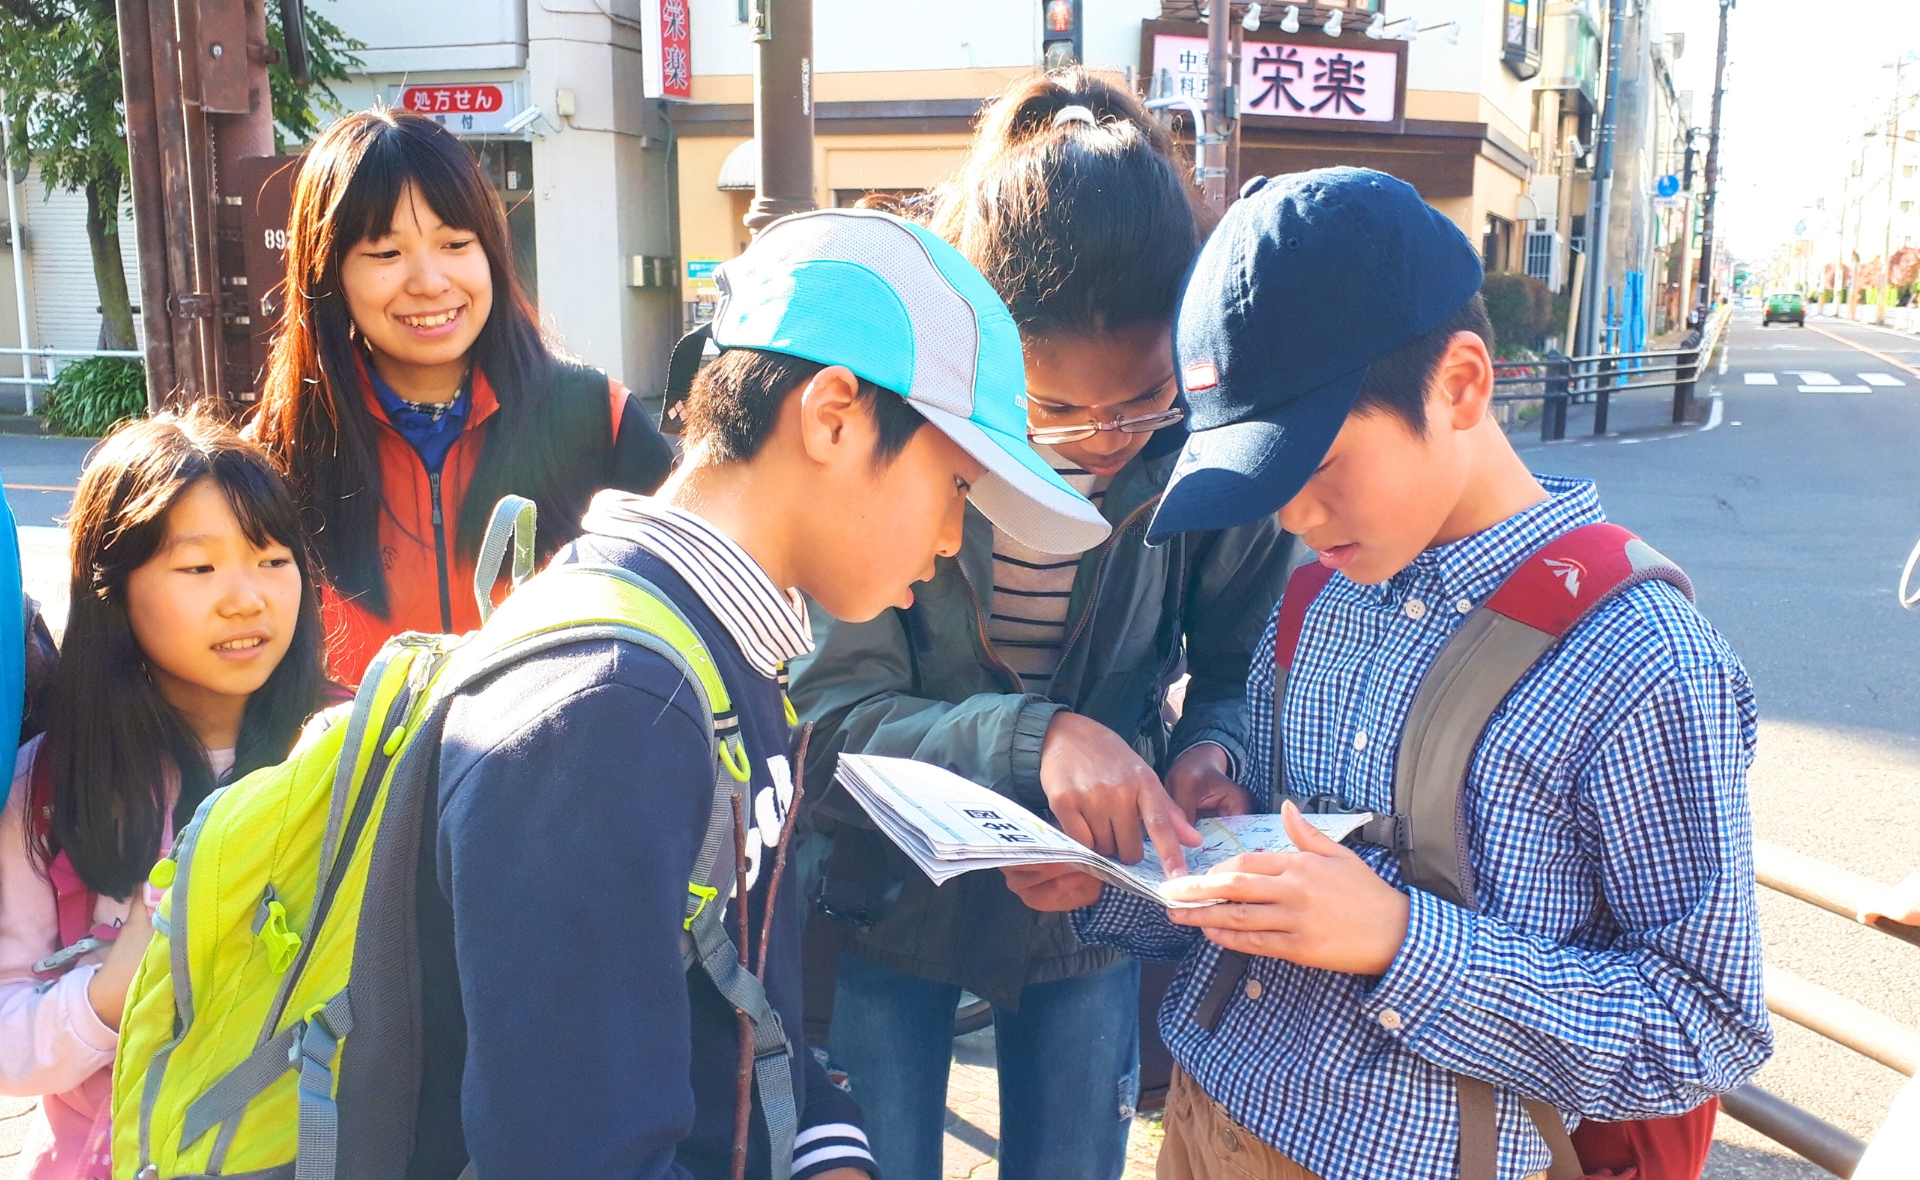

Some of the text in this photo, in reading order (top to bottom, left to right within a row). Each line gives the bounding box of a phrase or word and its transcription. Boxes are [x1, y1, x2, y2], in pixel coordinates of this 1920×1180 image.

[663, 0, 688, 90] 栄楽
[1249, 45, 1366, 115] 栄楽
[413, 89, 493, 111] 処方せん
